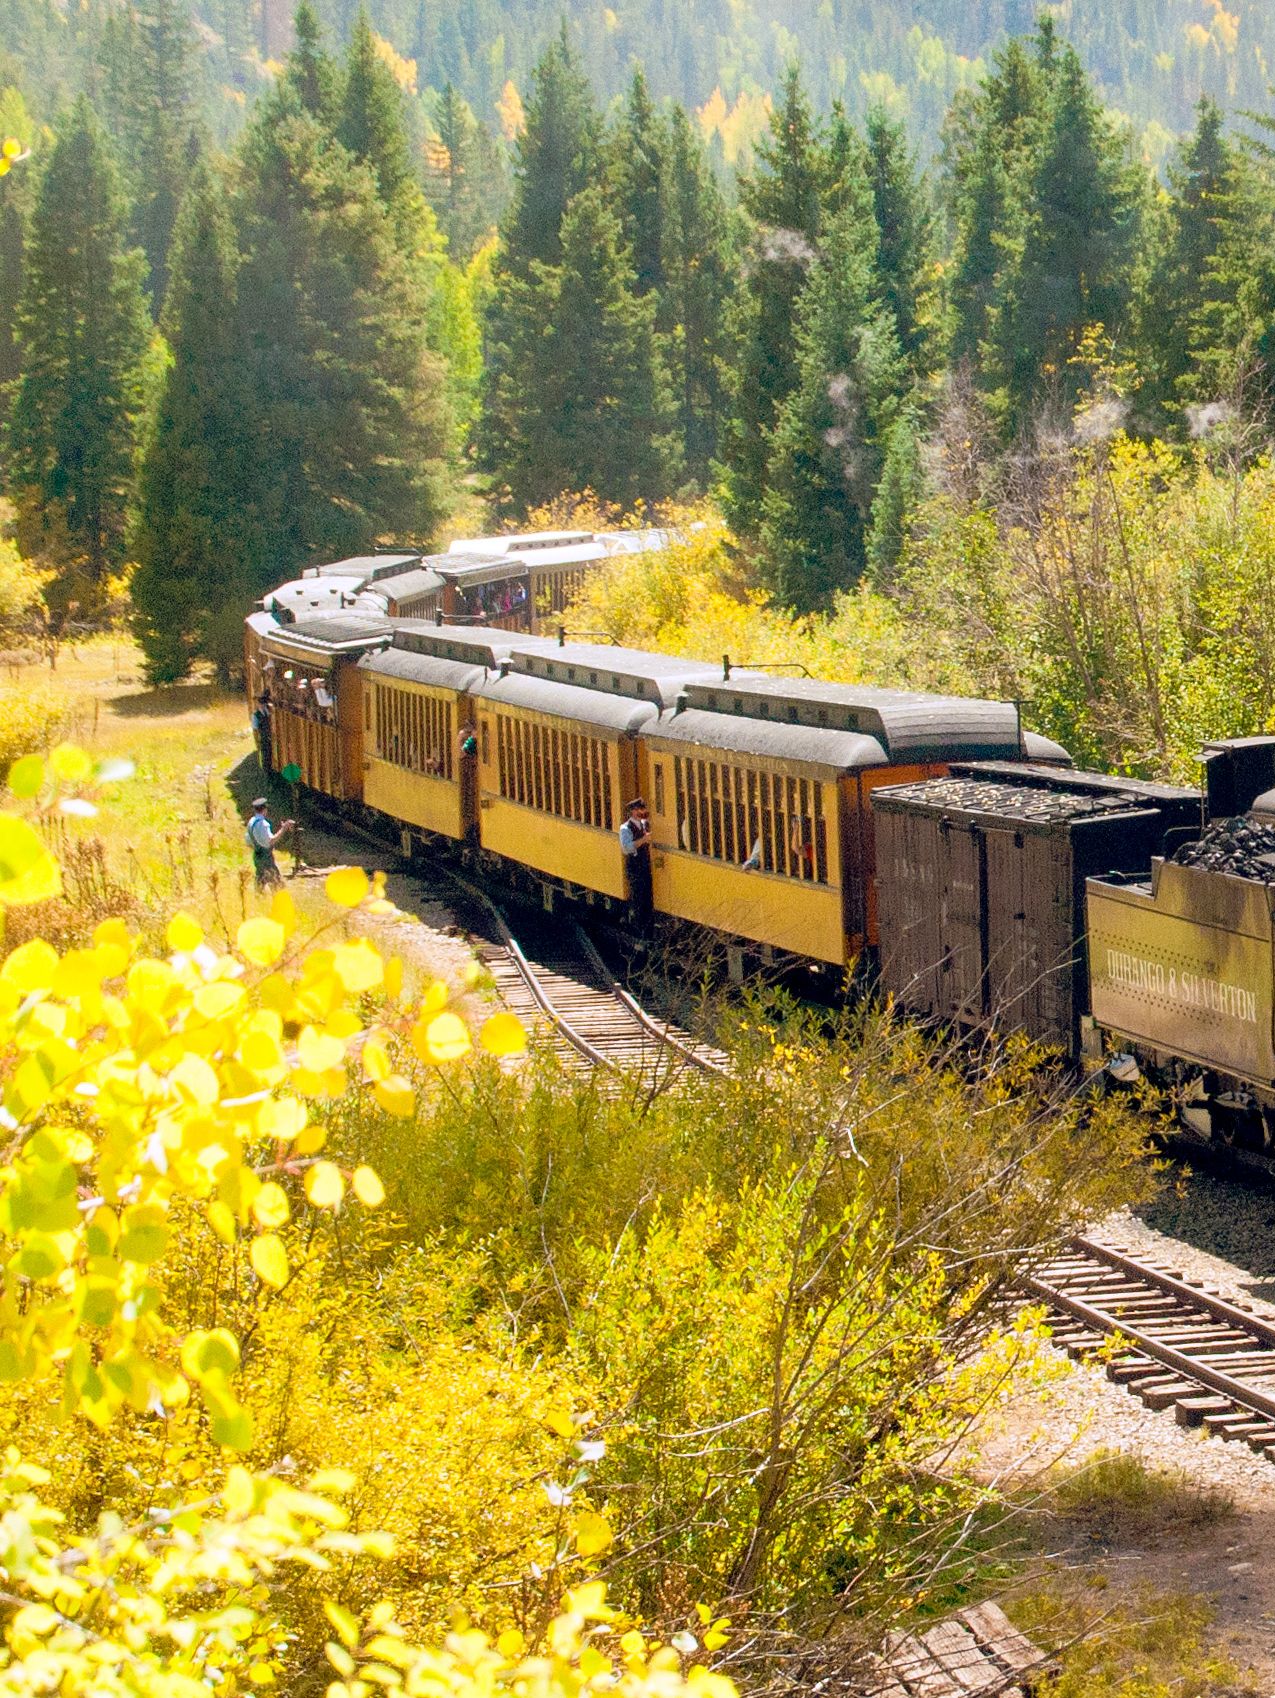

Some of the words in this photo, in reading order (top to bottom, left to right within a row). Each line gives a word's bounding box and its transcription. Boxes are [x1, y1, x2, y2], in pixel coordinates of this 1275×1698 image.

[1107, 949, 1165, 995] DURANGO
[1168, 967, 1177, 999] &
[1181, 971, 1257, 1023] SILVERTON
